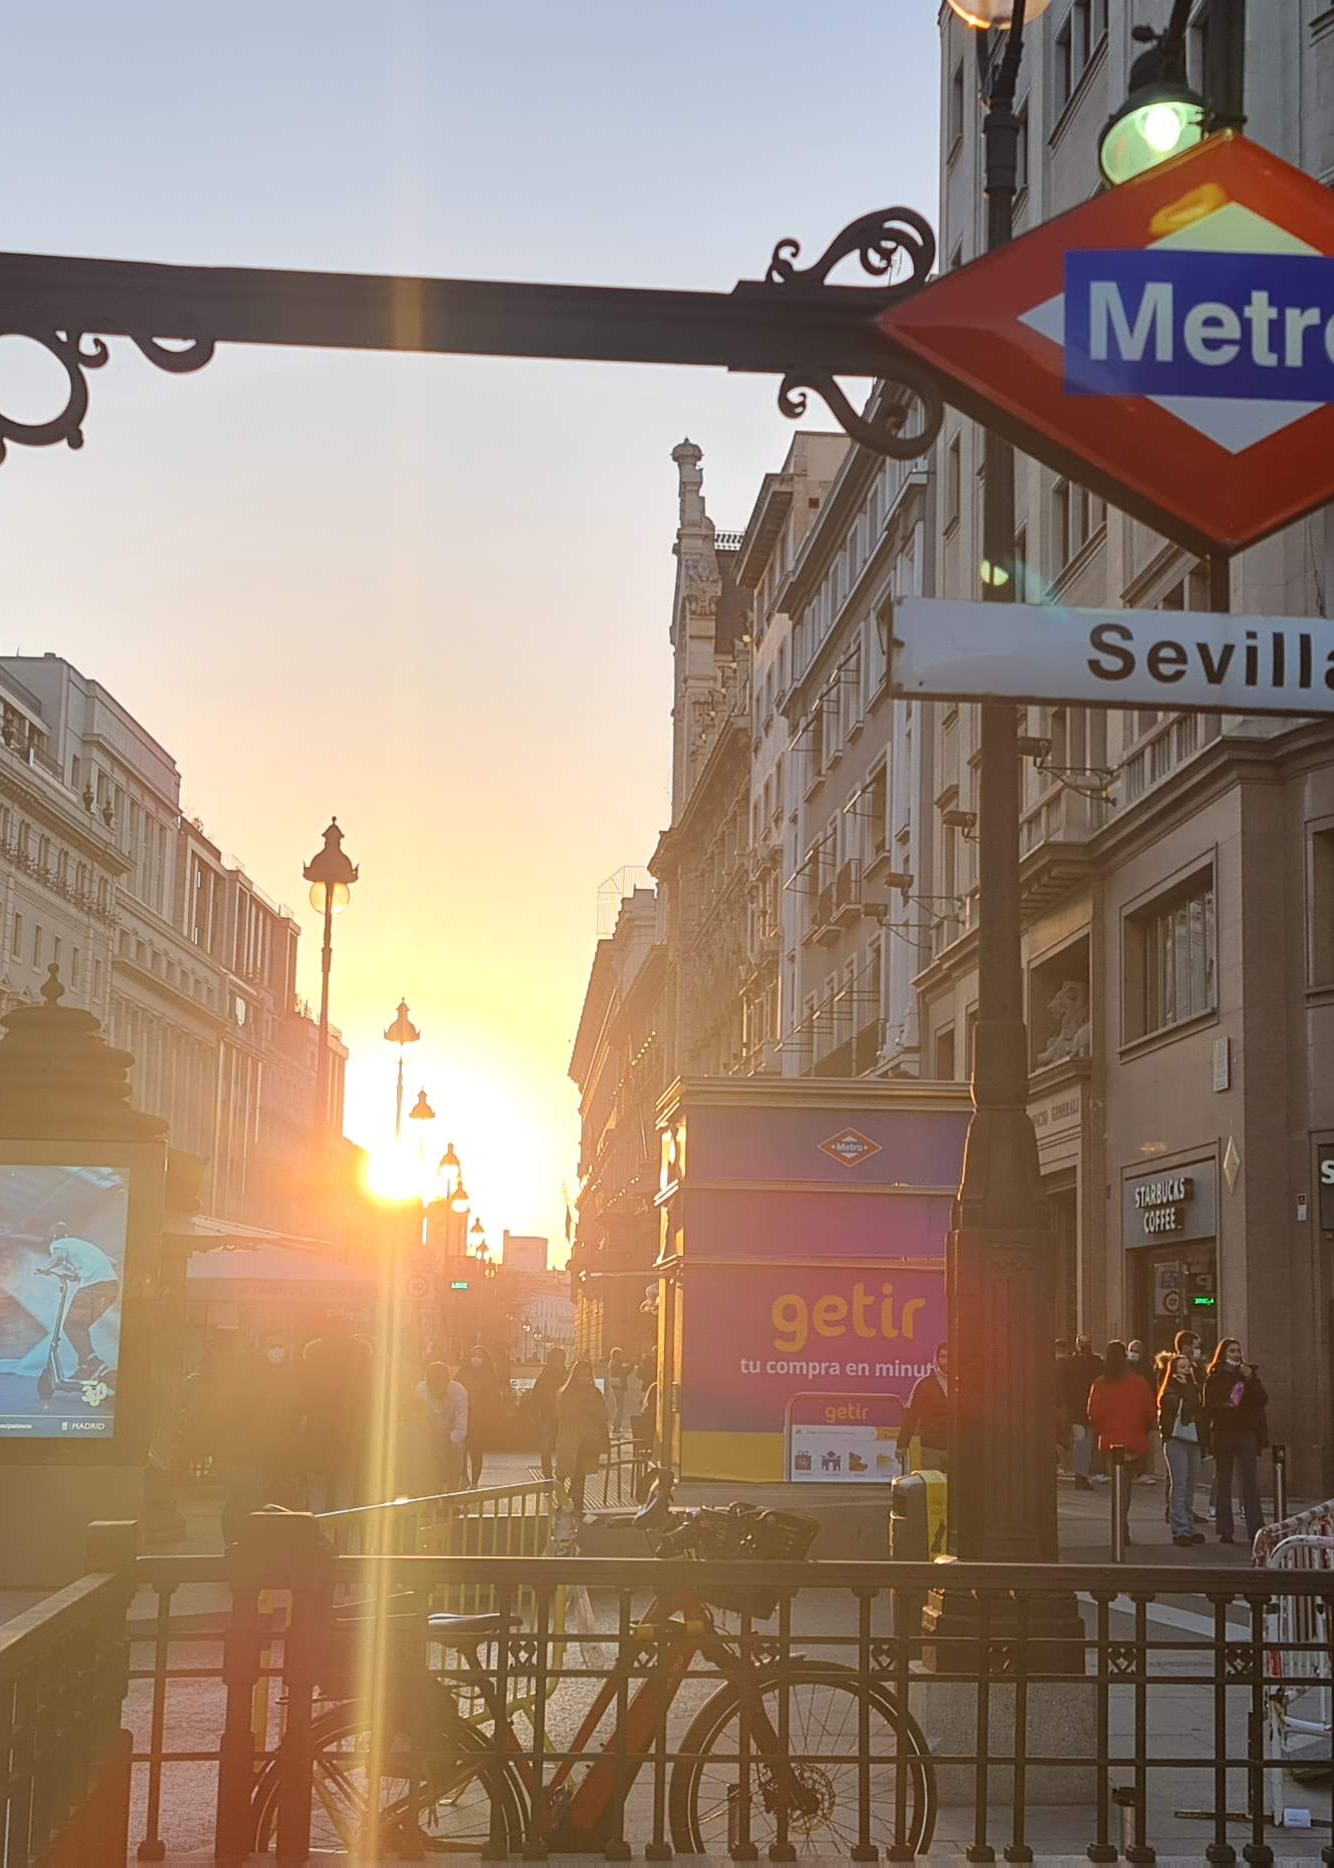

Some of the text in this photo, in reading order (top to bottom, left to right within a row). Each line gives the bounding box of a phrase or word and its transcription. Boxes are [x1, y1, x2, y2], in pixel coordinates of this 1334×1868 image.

[836, 1142, 863, 1152] Metro
[1135, 1177, 1186, 1209] STARBUCKS
[1143, 1207, 1176, 1233] COFFEE
[771, 1282, 927, 1352] getir
[740, 1358, 761, 1374] tu
[766, 1360, 841, 1379] compra
[846, 1362, 870, 1376] en
[825, 1403, 869, 1423] getir
[72, 1421, 105, 1430] MADRID
